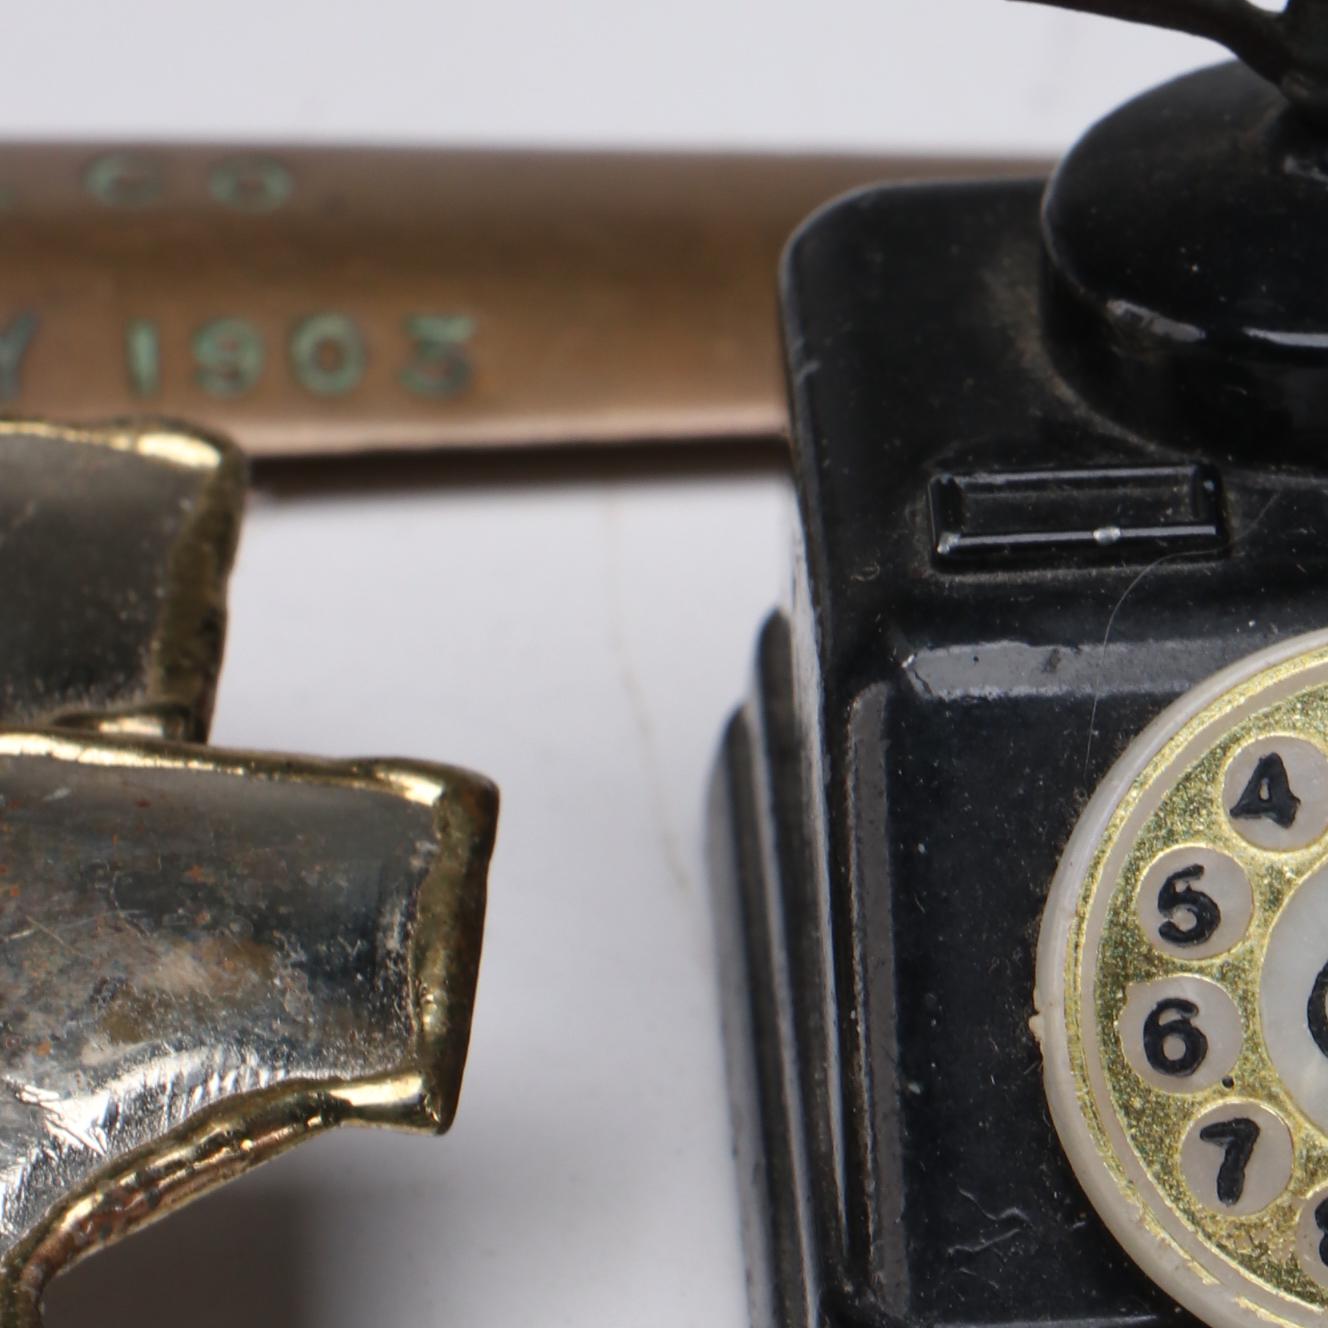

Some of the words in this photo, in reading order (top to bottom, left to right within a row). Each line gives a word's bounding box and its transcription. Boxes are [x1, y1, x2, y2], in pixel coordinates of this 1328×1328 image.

[124, 312, 479, 402] 1903
[1229, 752, 1302, 829] 4
[1157, 864, 1222, 948] 5
[1142, 997, 1209, 1079] 6
[1199, 1116, 1261, 1206] 7
